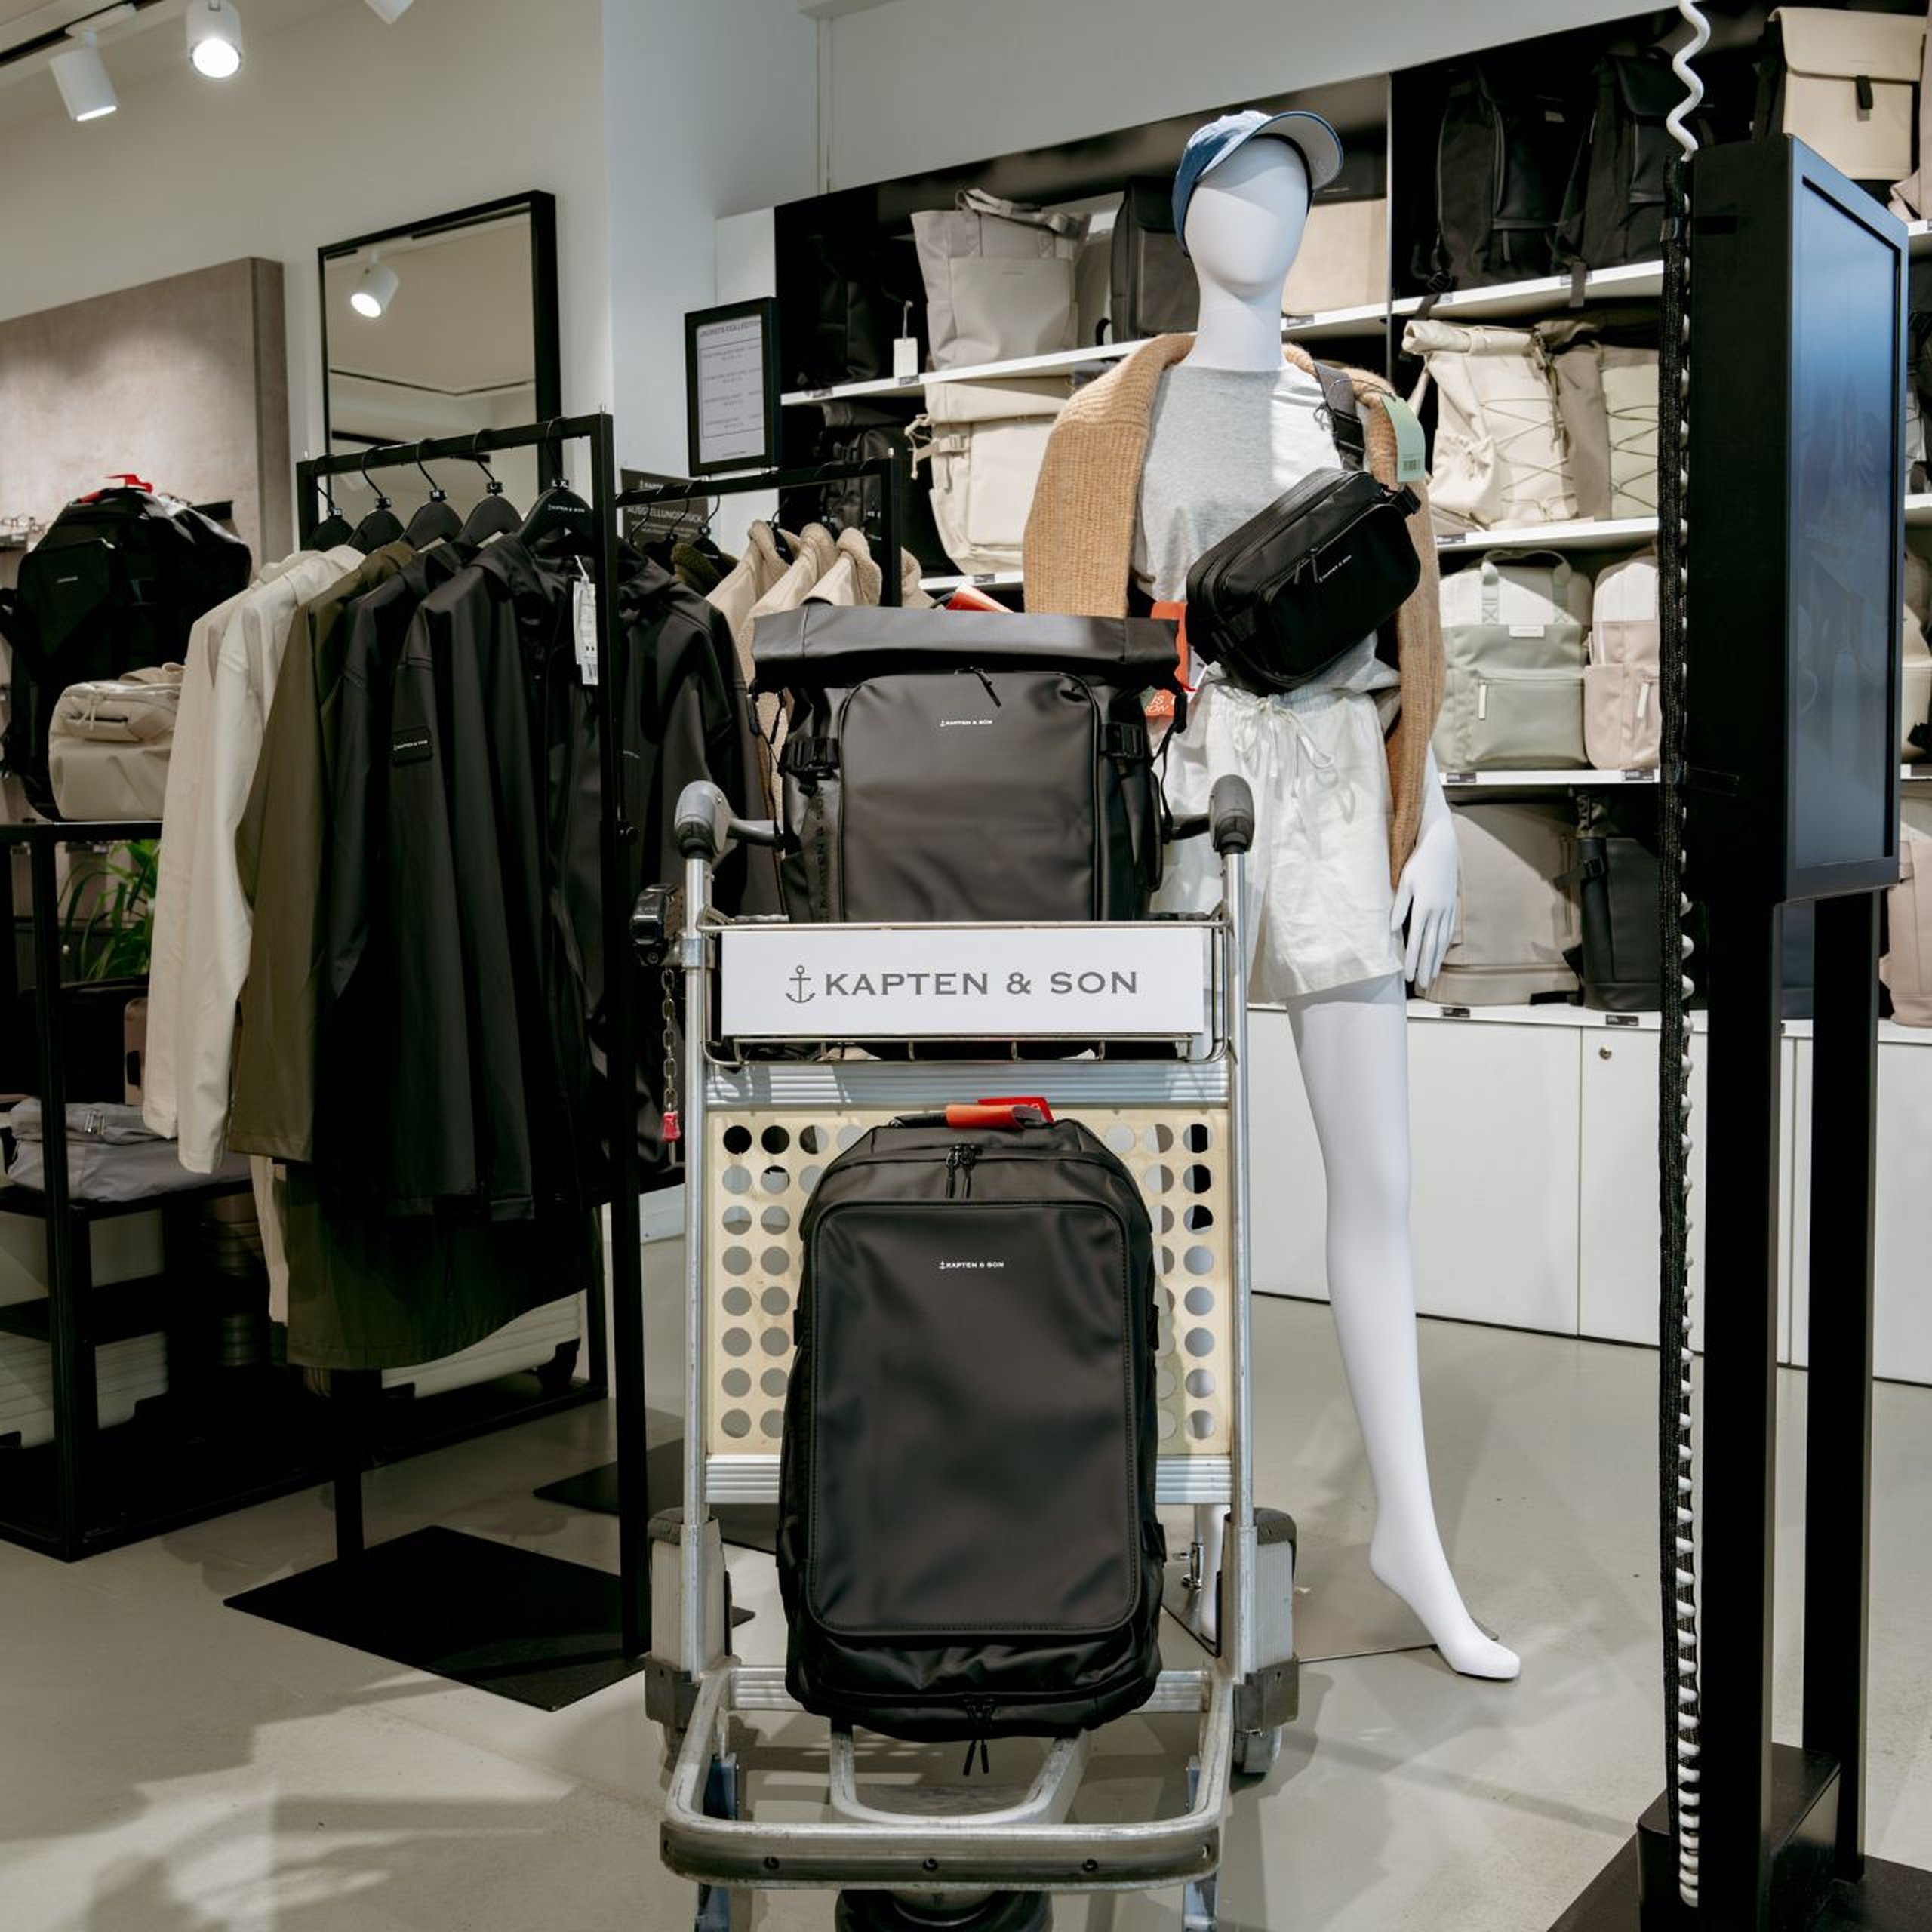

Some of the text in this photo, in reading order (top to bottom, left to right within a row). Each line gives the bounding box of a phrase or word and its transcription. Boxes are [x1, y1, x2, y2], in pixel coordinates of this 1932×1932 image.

[826, 971, 1137, 995] KAPTEN & SON
